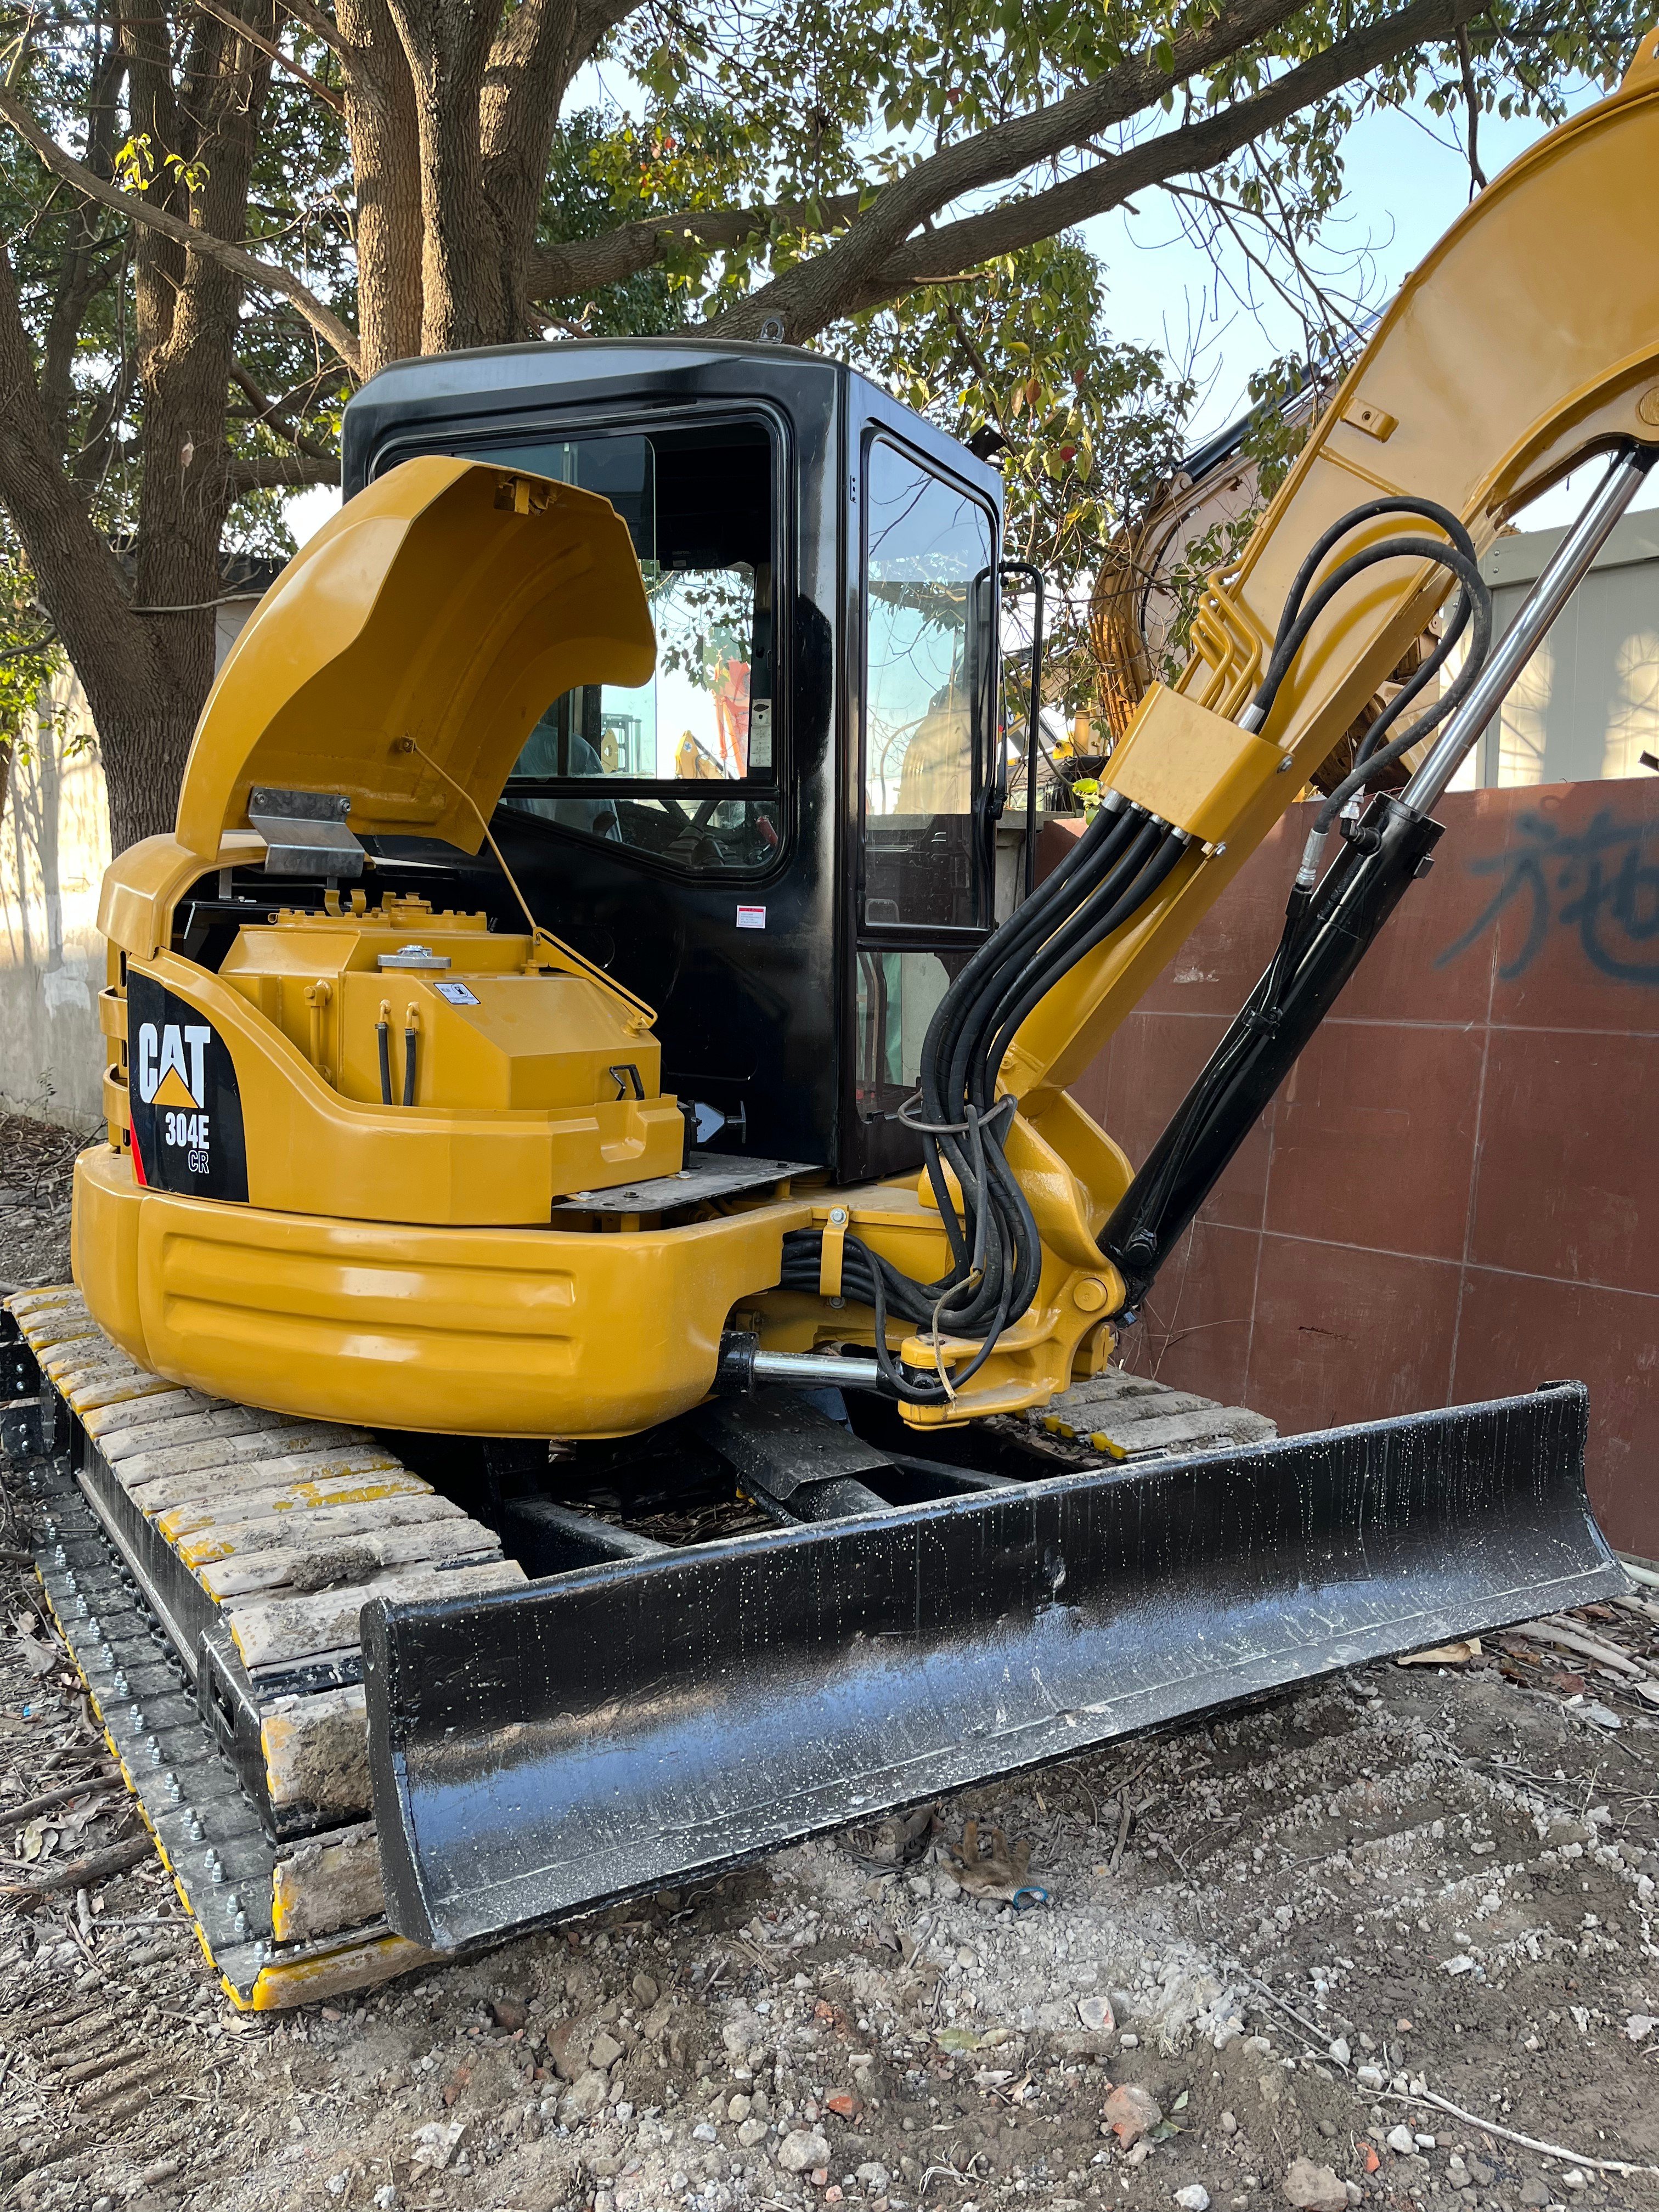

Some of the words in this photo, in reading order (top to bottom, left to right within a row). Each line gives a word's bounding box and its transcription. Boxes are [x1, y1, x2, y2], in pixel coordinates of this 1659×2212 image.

[139, 1023, 211, 1109] CAT
[165, 1111, 210, 1149] 304E
[188, 1149, 210, 1174] CR
